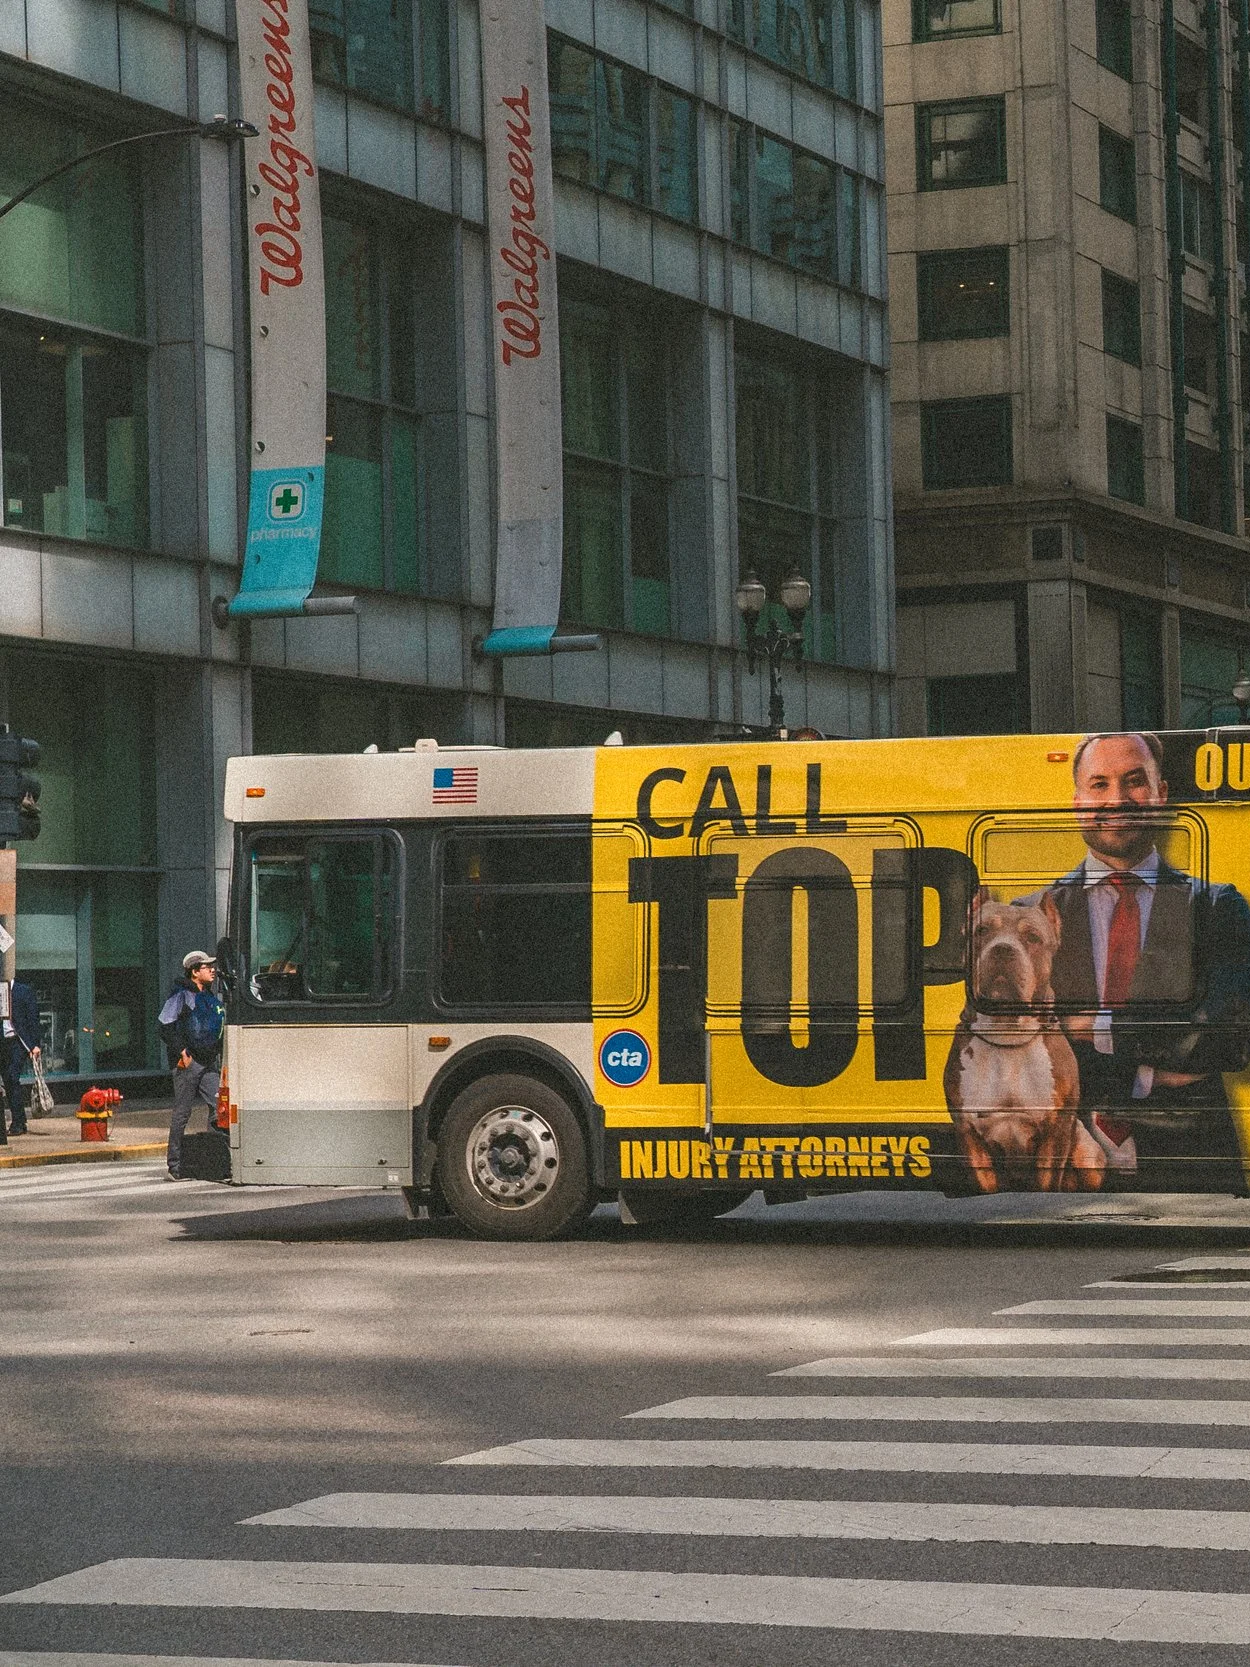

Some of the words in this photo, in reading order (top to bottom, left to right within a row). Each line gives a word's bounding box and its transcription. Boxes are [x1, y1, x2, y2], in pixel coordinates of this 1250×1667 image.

[497, 84, 550, 367] Walgreens
[251, 527, 317, 544] pharmacy
[637, 762, 847, 839] CALL
[628, 846, 978, 1087] TOP
[607, 1047, 642, 1068] cta
[620, 1137, 734, 1179] INJURY
[739, 1136, 932, 1179] ATTORNEYS
